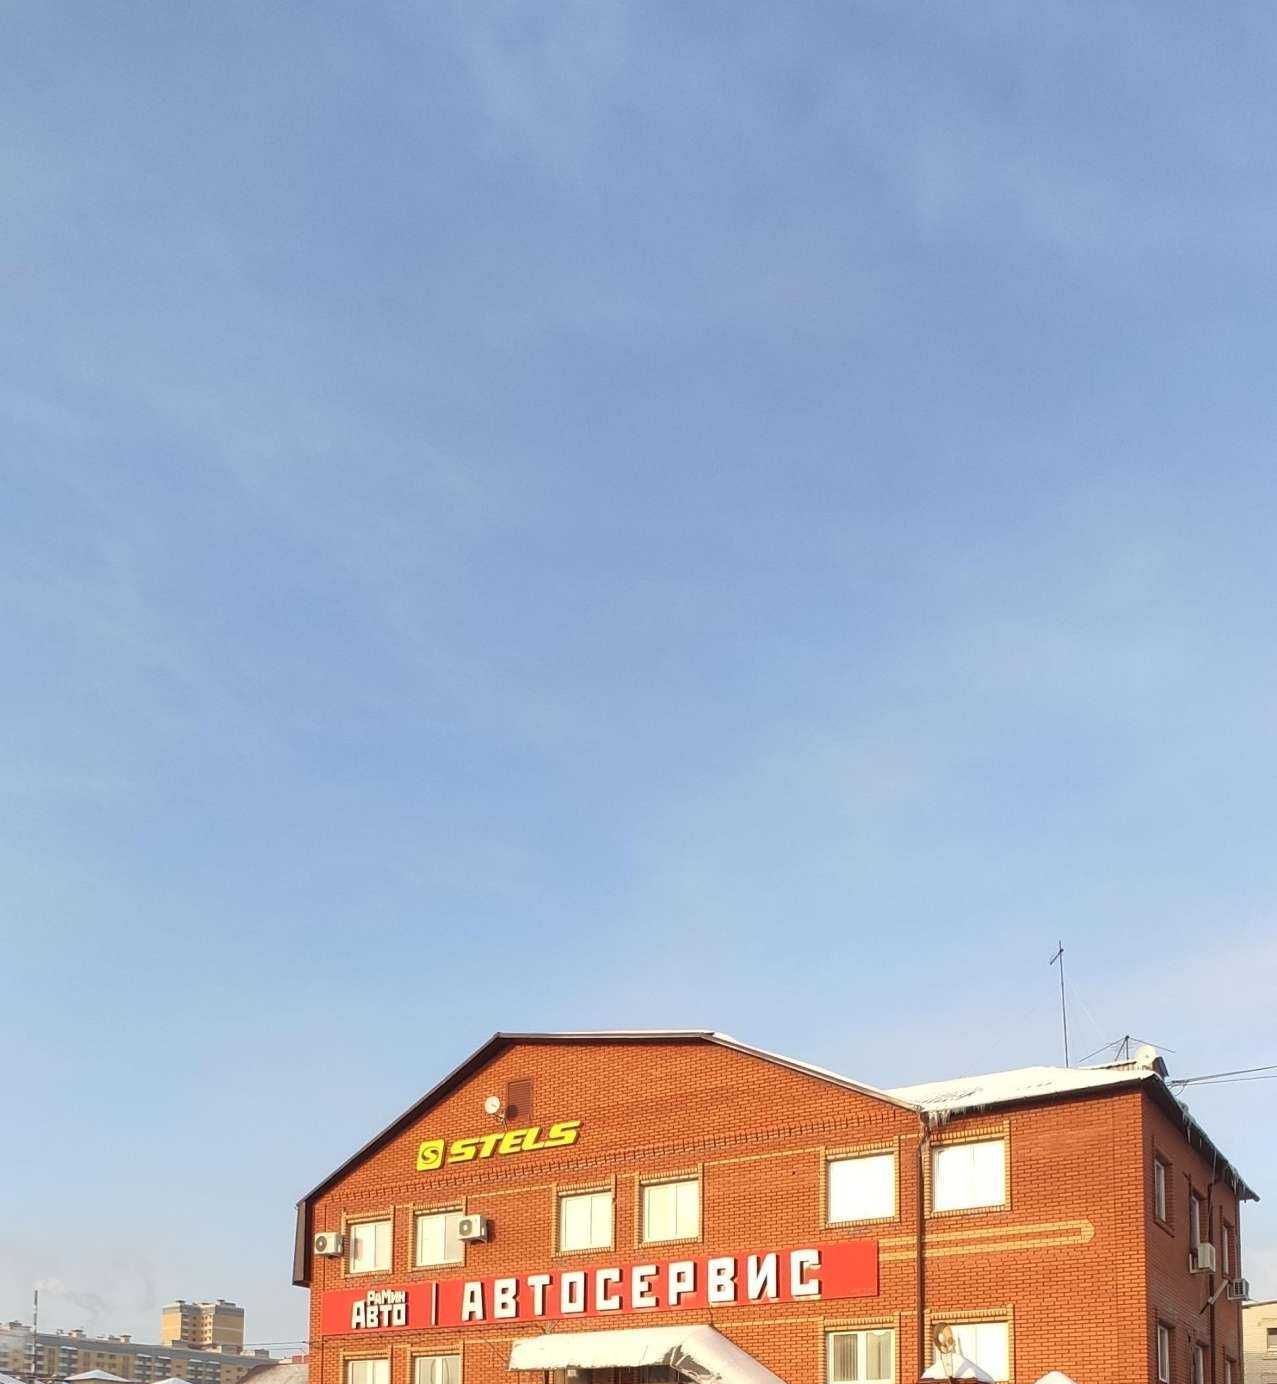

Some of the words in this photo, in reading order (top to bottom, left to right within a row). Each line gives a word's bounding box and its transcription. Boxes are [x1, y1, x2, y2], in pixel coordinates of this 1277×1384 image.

[448, 1120, 582, 1163] STELS
[462, 1248, 821, 1321] АВТОСЕРВИС
[351, 1300, 406, 1329] АВТО
